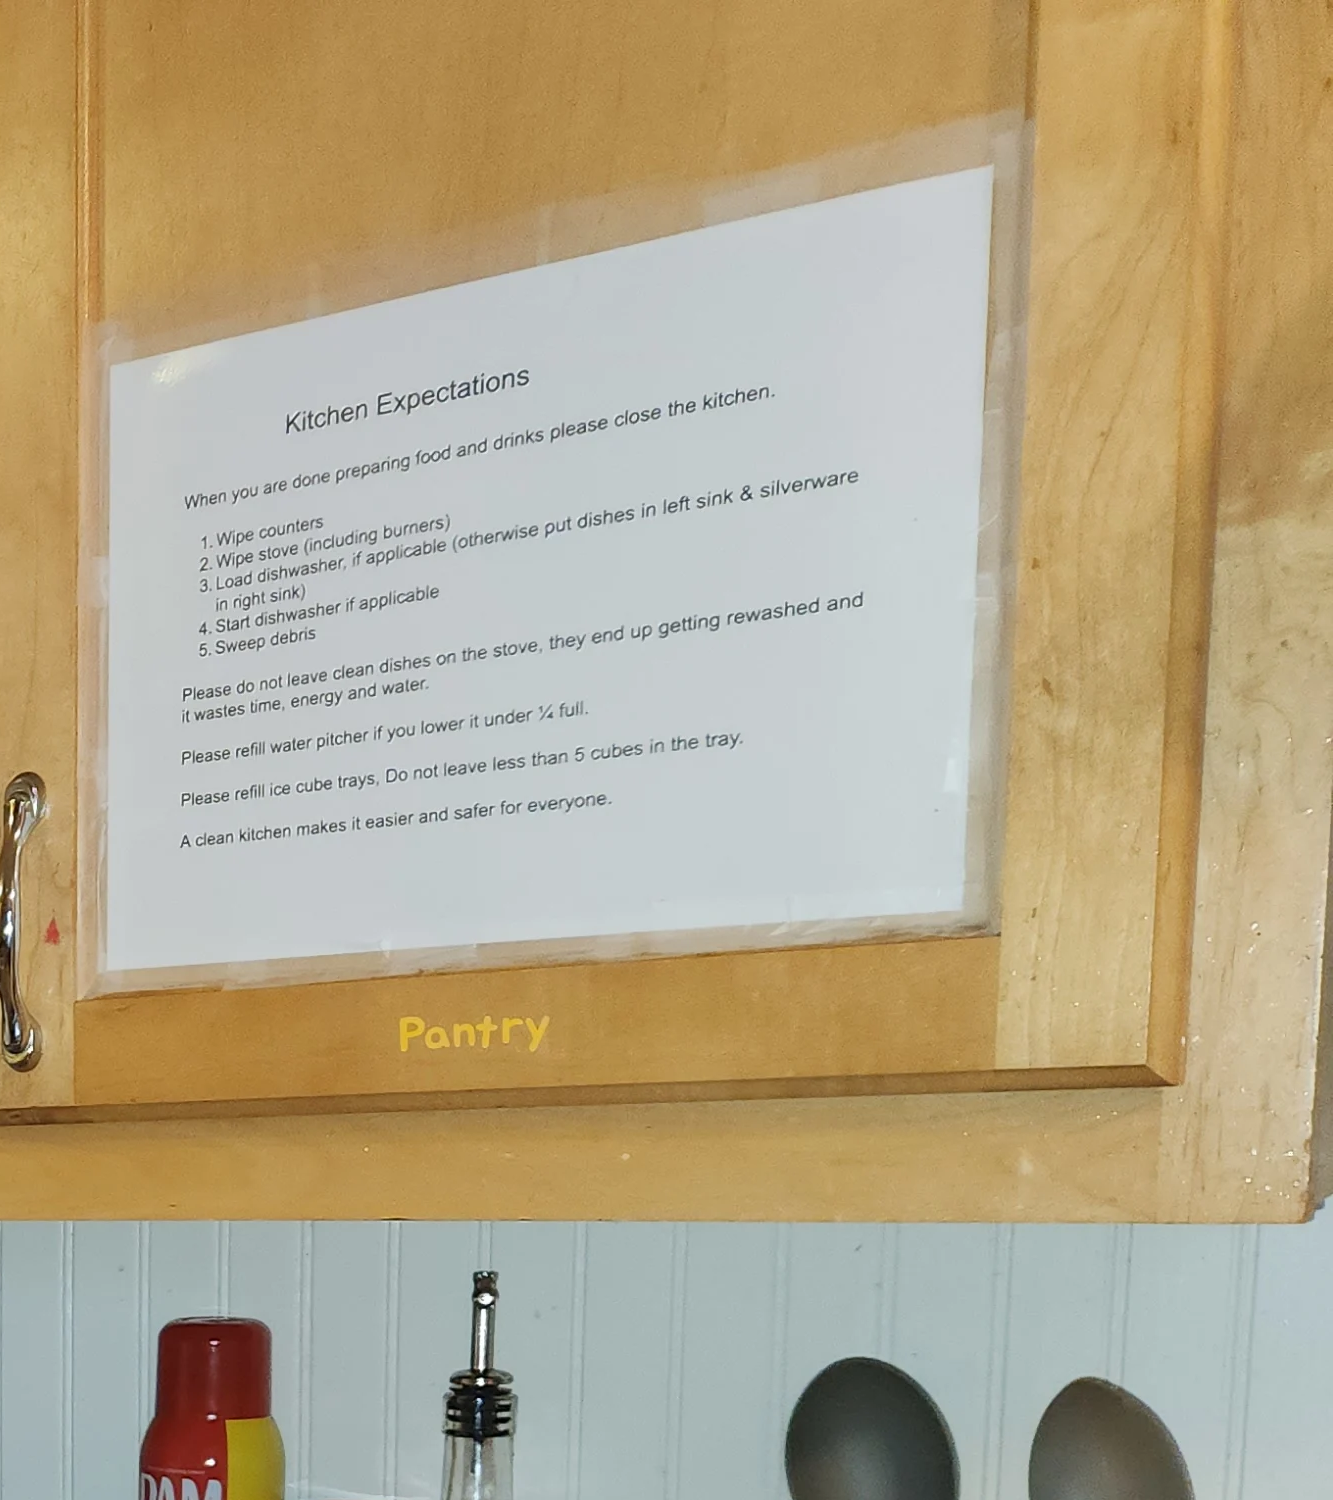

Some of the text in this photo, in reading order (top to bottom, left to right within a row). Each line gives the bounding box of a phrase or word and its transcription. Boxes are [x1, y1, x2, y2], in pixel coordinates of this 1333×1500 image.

[286, 369, 529, 434] Kitchen Expectations
[185, 386, 775, 510] When you are done preparing food and drinks please close the kitchen.
[200, 470, 858, 593] 3. Load dishwasher, if applicable (otherwise put dishes in left sink & silverware
[200, 514, 450, 572] 2. Wipe stove (including burners)
[202, 517, 323, 549] 1. Wipe counters
[199, 585, 439, 636] 4. Start dishwasher if applicable
[216, 584, 305, 612] in right sink)
[183, 591, 863, 702] Please do not leave clean dishes on the stove, they end up getting rewashed and
[199, 626, 316, 658] 5. Sweep debris
[182, 679, 429, 723] it wastes time, energy and water.
[182, 749, 230, 765] Please
[236, 741, 265, 759] refill
[270, 738, 312, 754] water
[317, 730, 369, 752] pitcher
[374, 725, 383, 741] if
[387, 725, 415, 743] you
[421, 719, 465, 735] lower
[470, 714, 478, 729] it
[485, 709, 533, 727] under
[559, 700, 588, 718] full.
[181, 733, 743, 807] Please refill ice cube trays, Do not leave less than 5 cubes in the tray.
[180, 793, 612, 849] A clean kitchen makes it easier and safer for everyone.
[399, 1015, 550, 1052] Pantry
